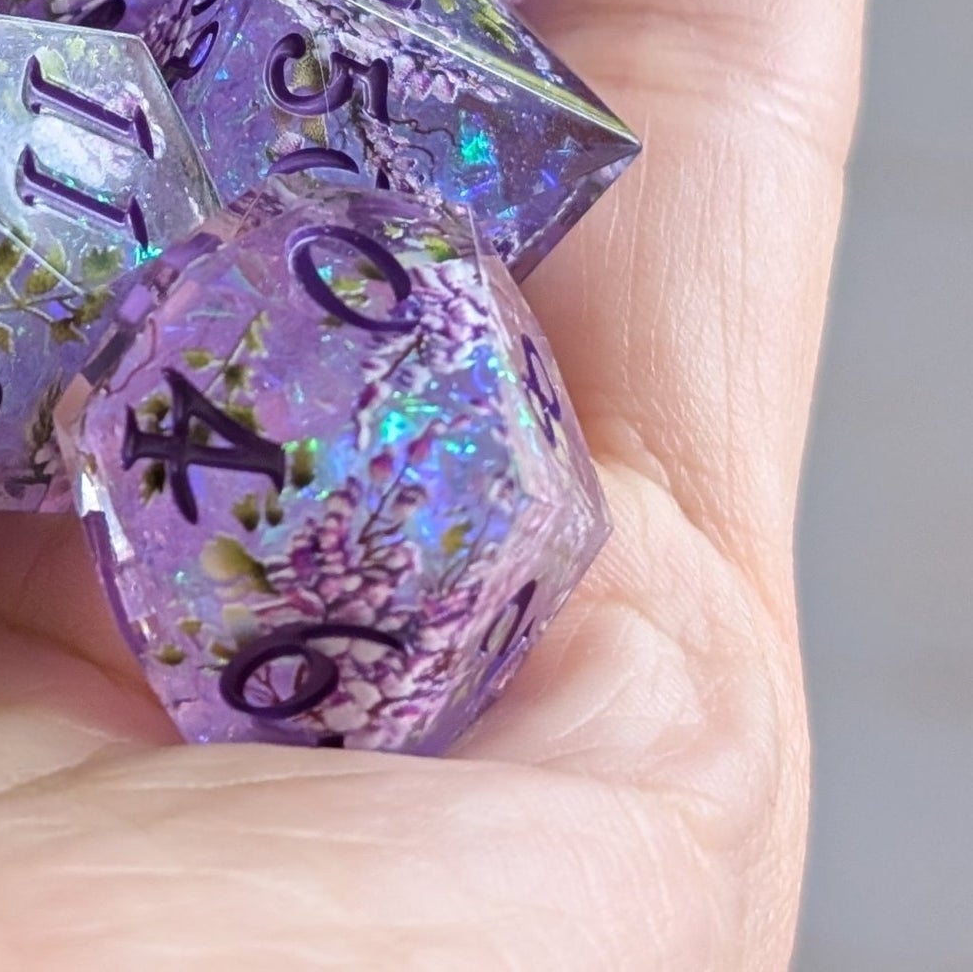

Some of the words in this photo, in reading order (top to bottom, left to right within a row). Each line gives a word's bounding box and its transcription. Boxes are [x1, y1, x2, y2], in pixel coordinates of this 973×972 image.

[14, 52, 164, 251] 11
[283, 222, 423, 332] 0
[120, 366, 287, 527] 4
